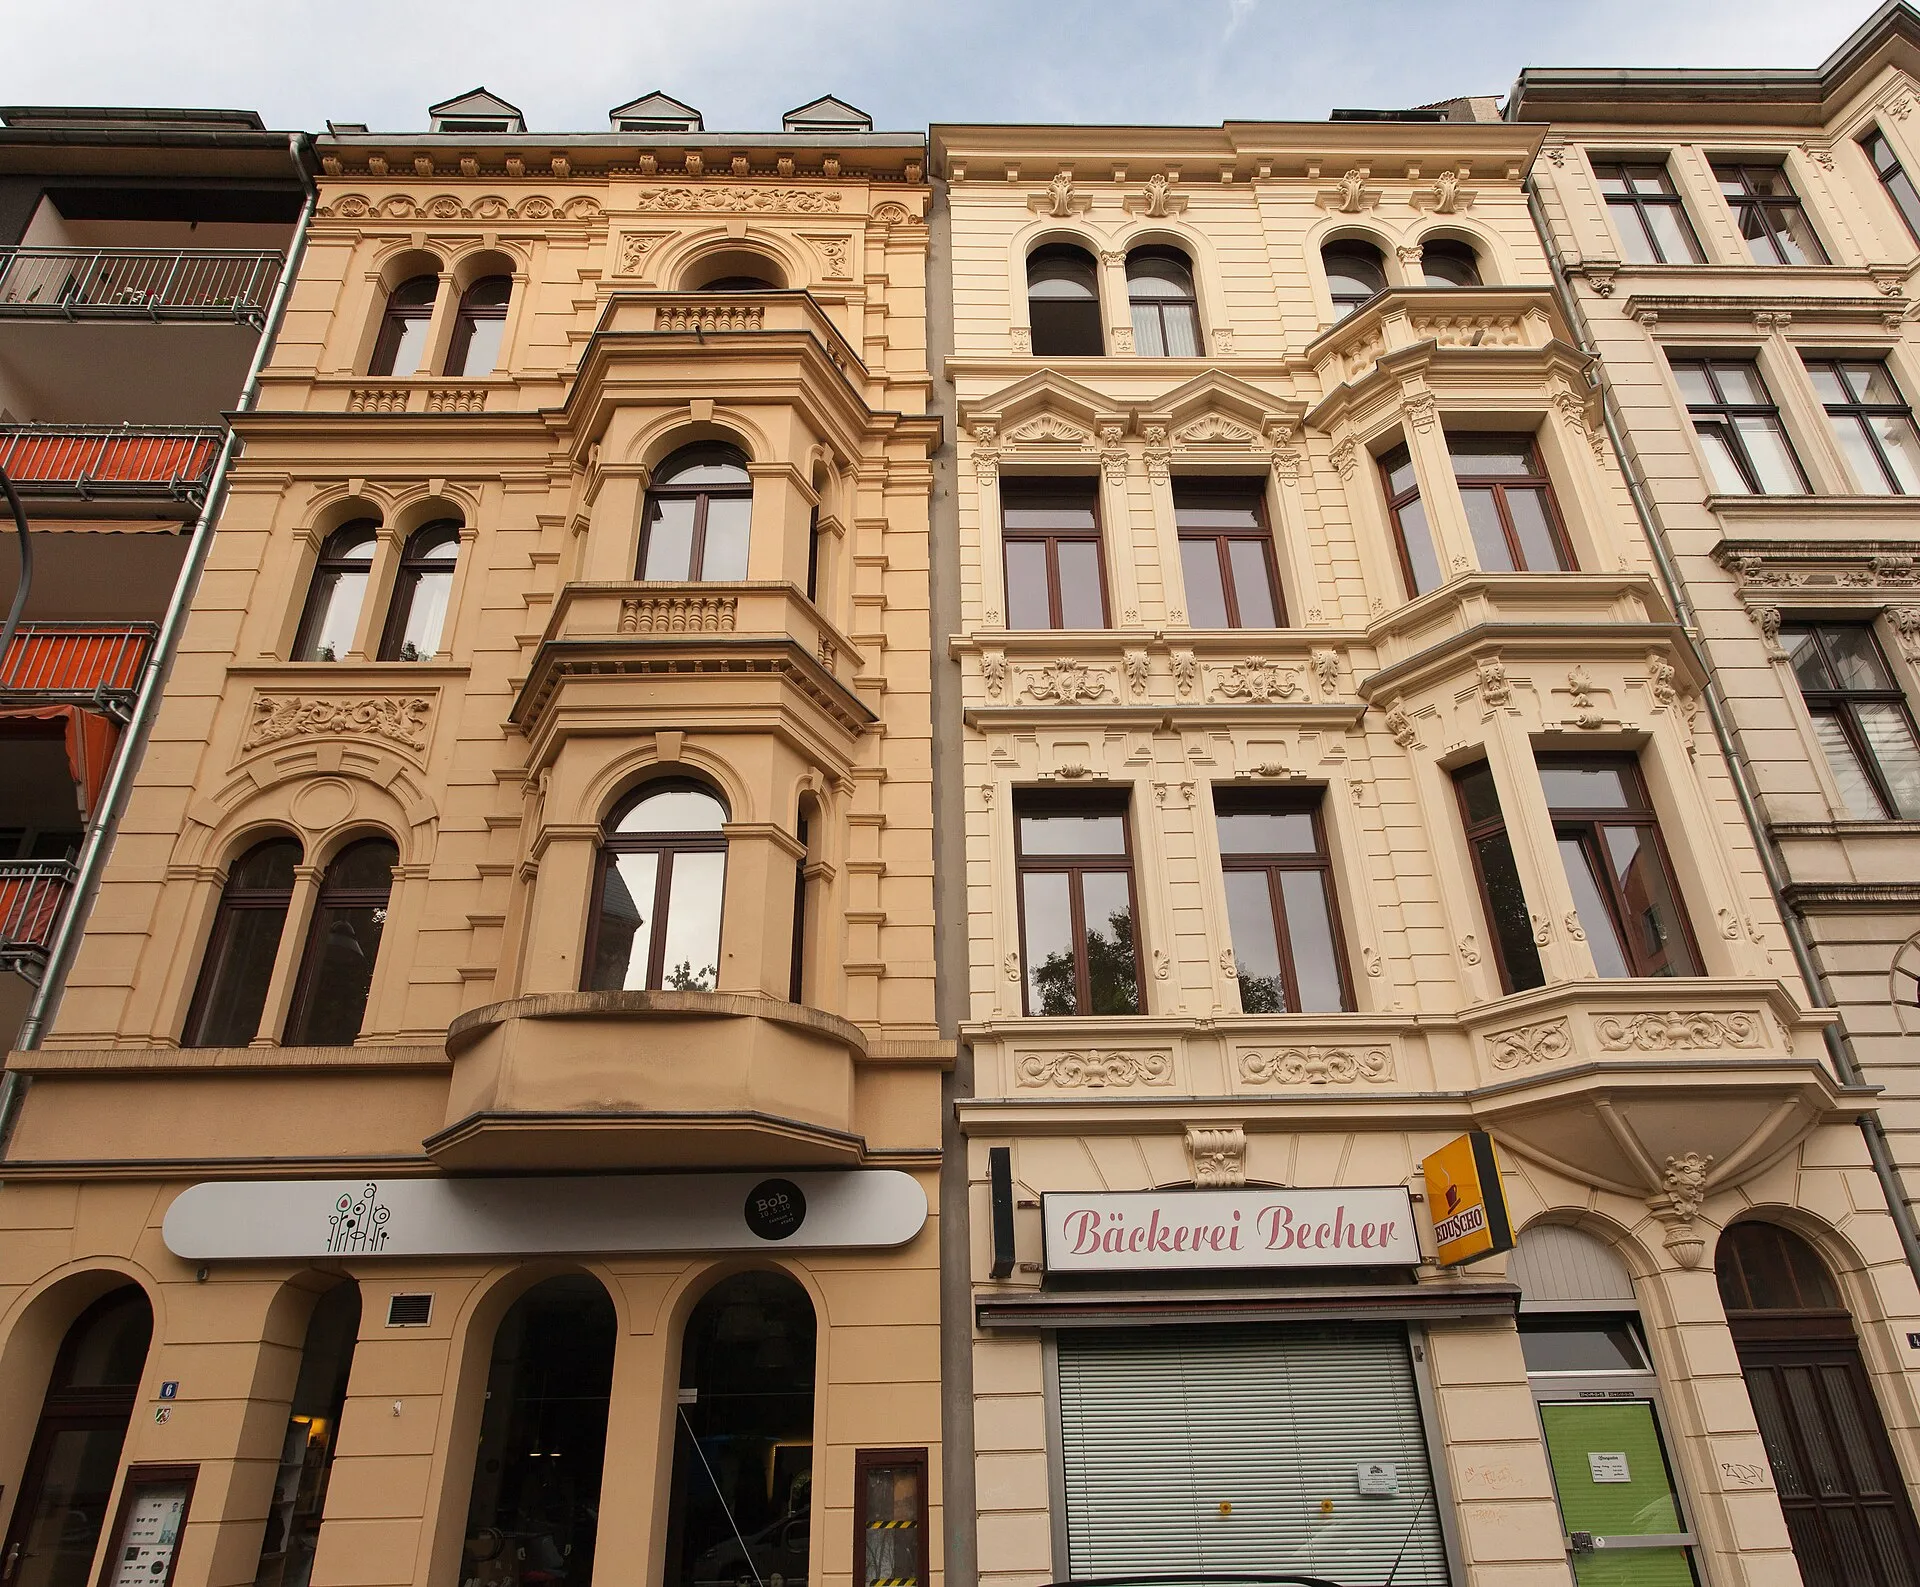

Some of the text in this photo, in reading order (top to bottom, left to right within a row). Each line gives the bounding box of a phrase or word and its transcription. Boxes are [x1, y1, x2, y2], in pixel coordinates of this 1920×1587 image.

[756, 1193, 788, 1212] Bob
[1063, 1205, 1398, 1255] Bäckerei Becher
[1435, 1208, 1483, 1244] EDUSCHO
[165, 1384, 173, 1397] 6
